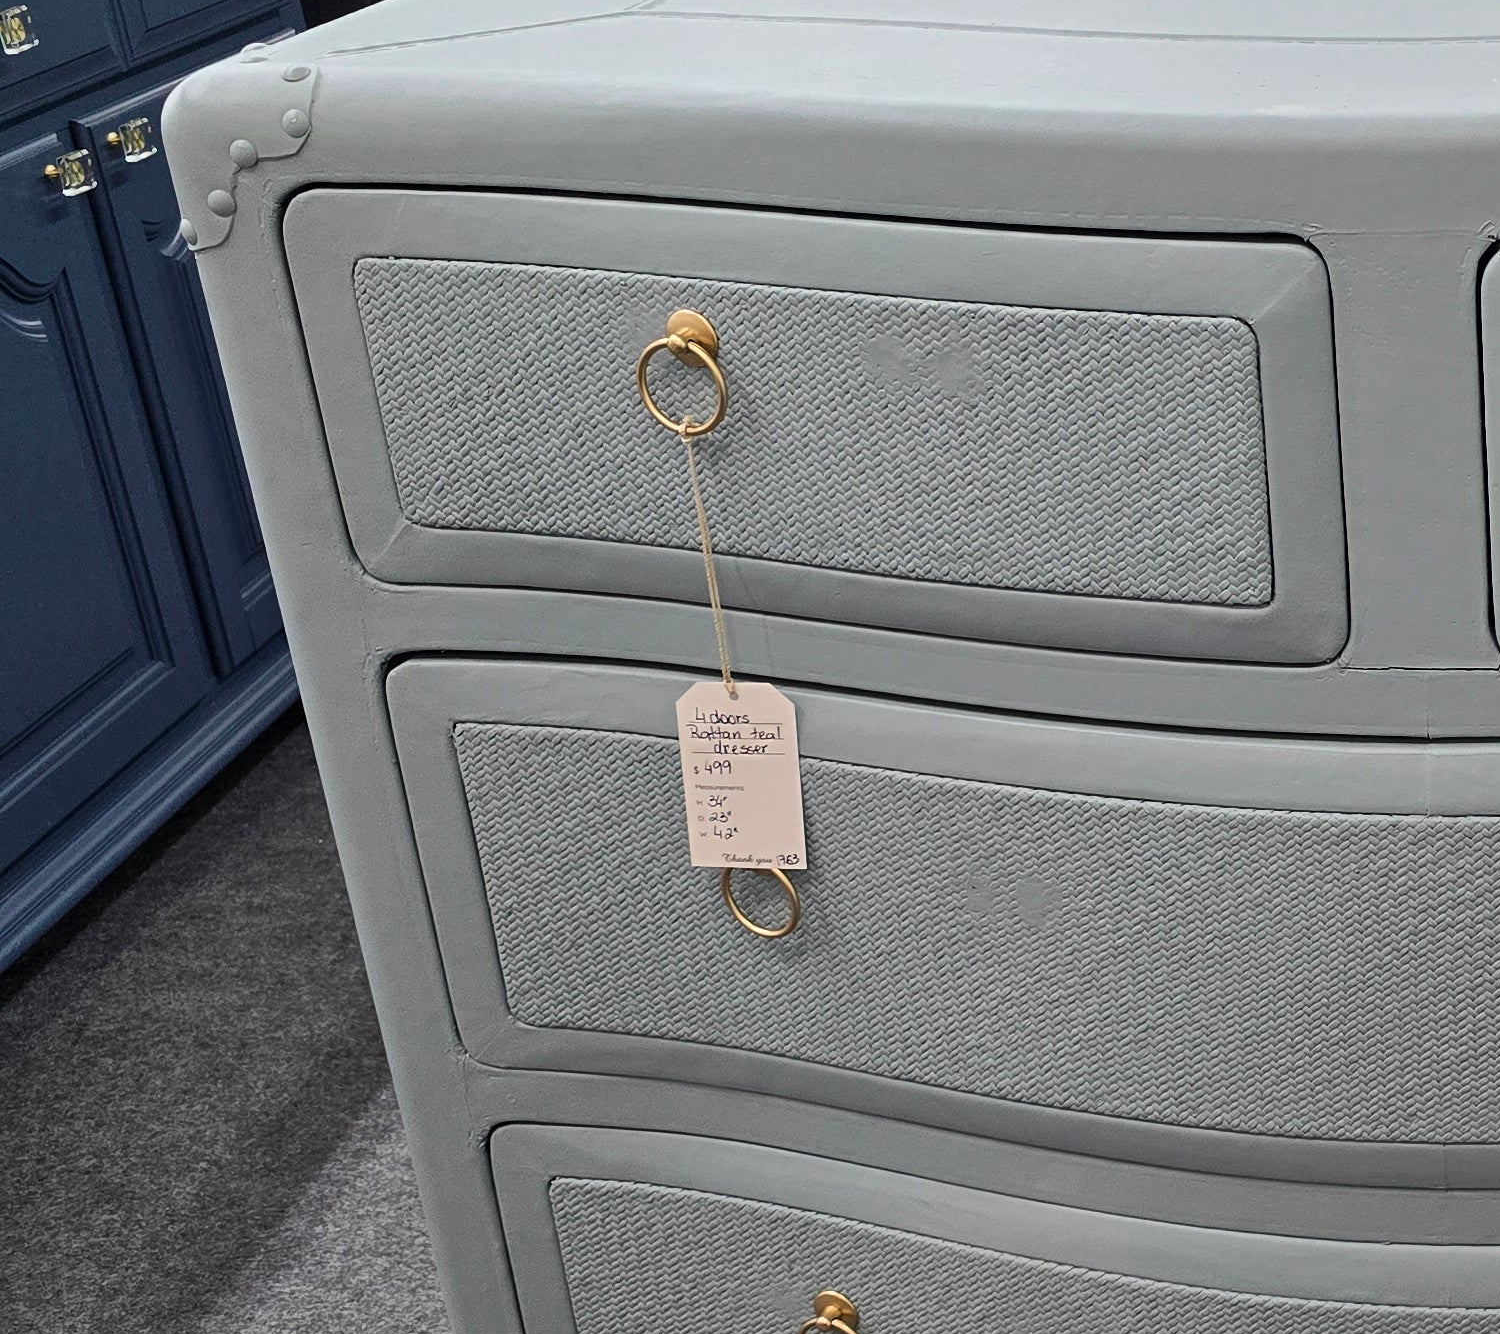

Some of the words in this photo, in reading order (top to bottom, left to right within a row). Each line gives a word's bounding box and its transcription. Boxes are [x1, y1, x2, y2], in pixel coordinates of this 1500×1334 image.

[709, 709, 750, 725] doors
[750, 726, 782, 740] teal
[713, 740, 768, 755] dresser
[721, 853, 753, 864] Thank
[756, 858, 773, 866] you
